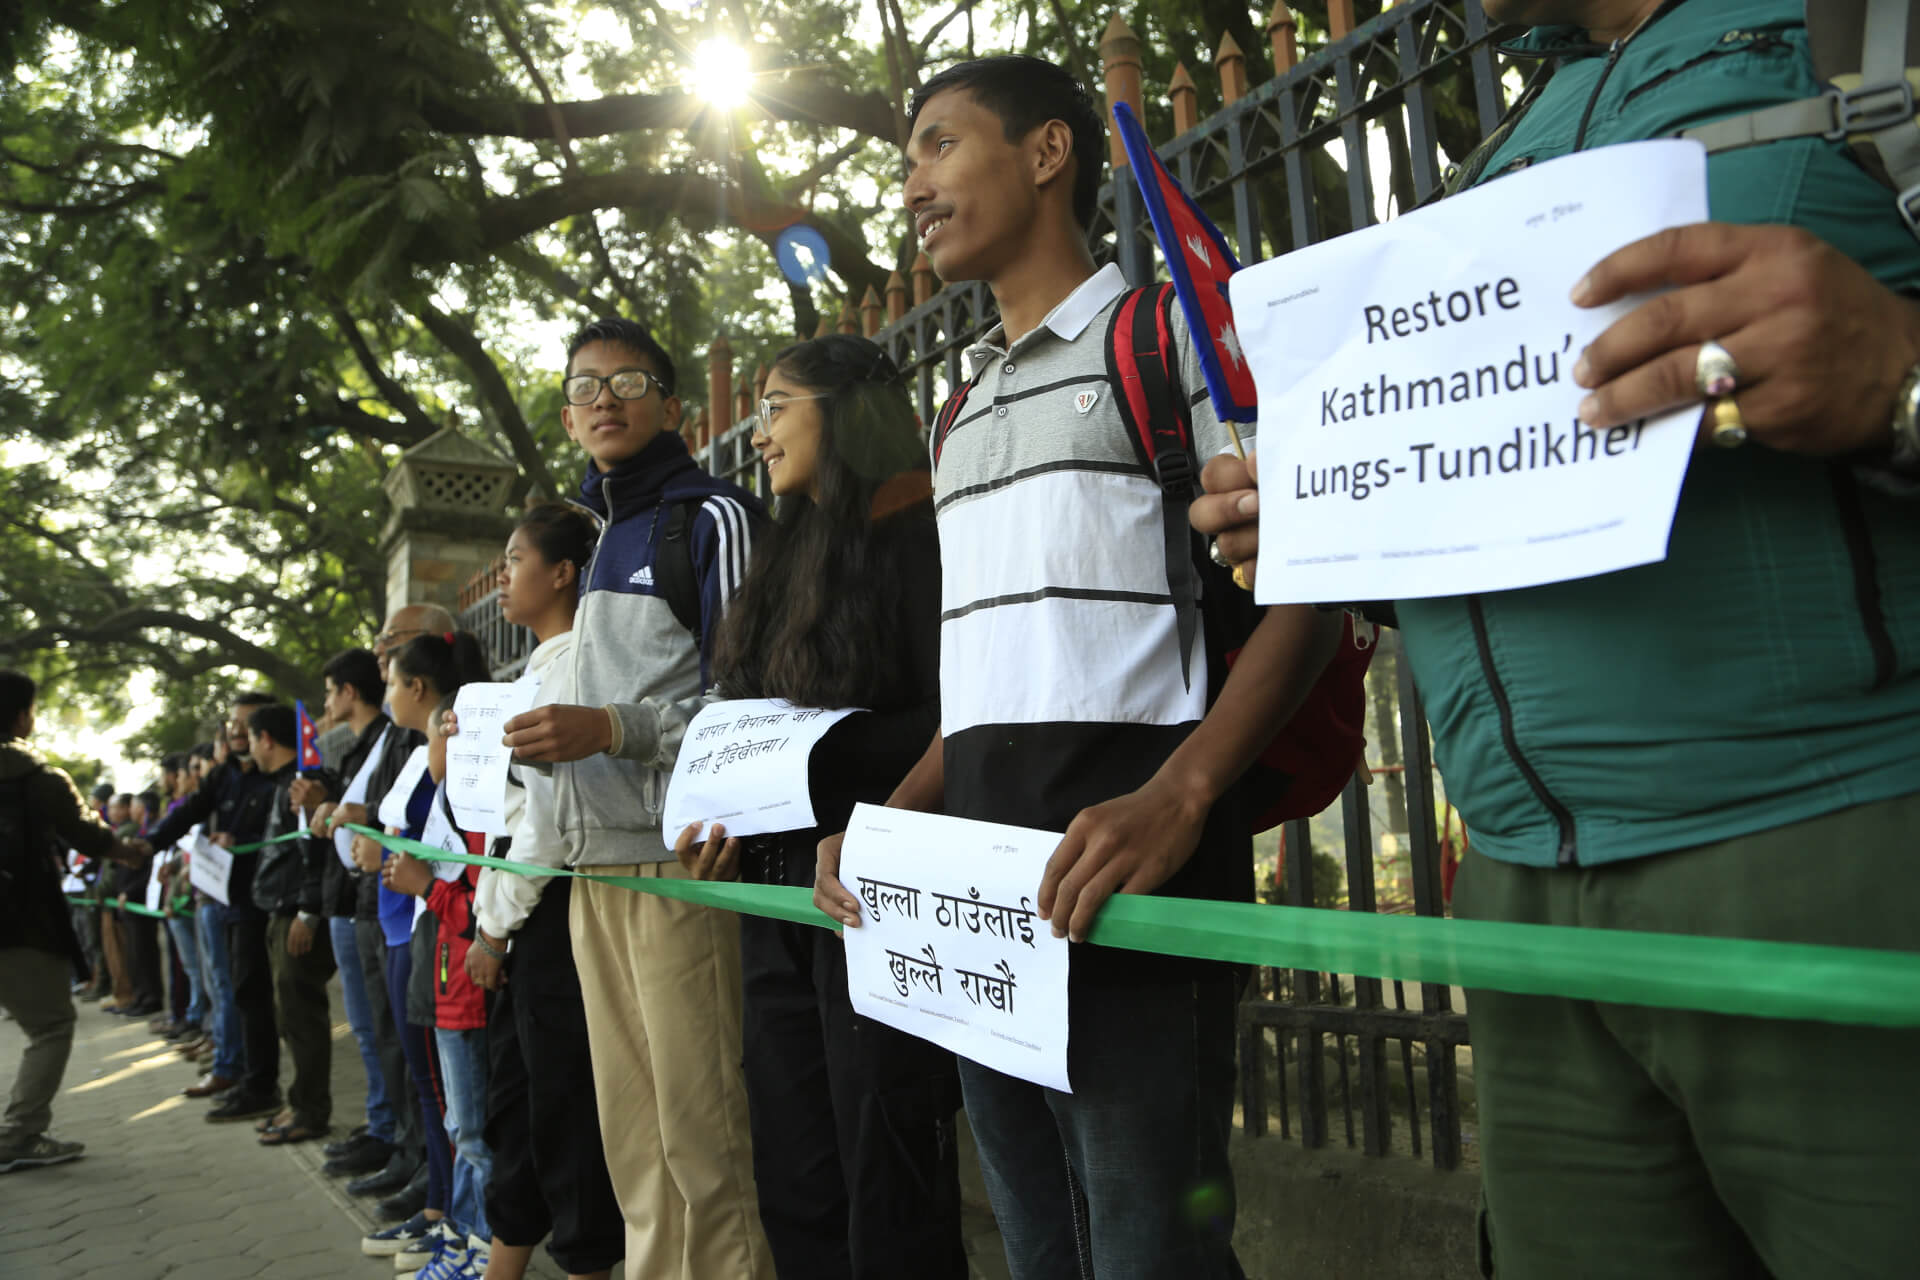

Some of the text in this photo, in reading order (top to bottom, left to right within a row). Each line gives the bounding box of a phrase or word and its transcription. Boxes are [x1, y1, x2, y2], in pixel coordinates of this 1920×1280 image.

[1364, 275, 1522, 344] Restore
[1320, 334, 1573, 426] Kathmandu’
[687, 750, 714, 775] कहाँ
[695, 722, 732, 742] आपत
[732, 713, 789, 733] विपतमा
[856, 876, 1038, 949] खुल्ला ठाउँलाई
[885, 943, 1018, 1016] खुल्लै राखौं
